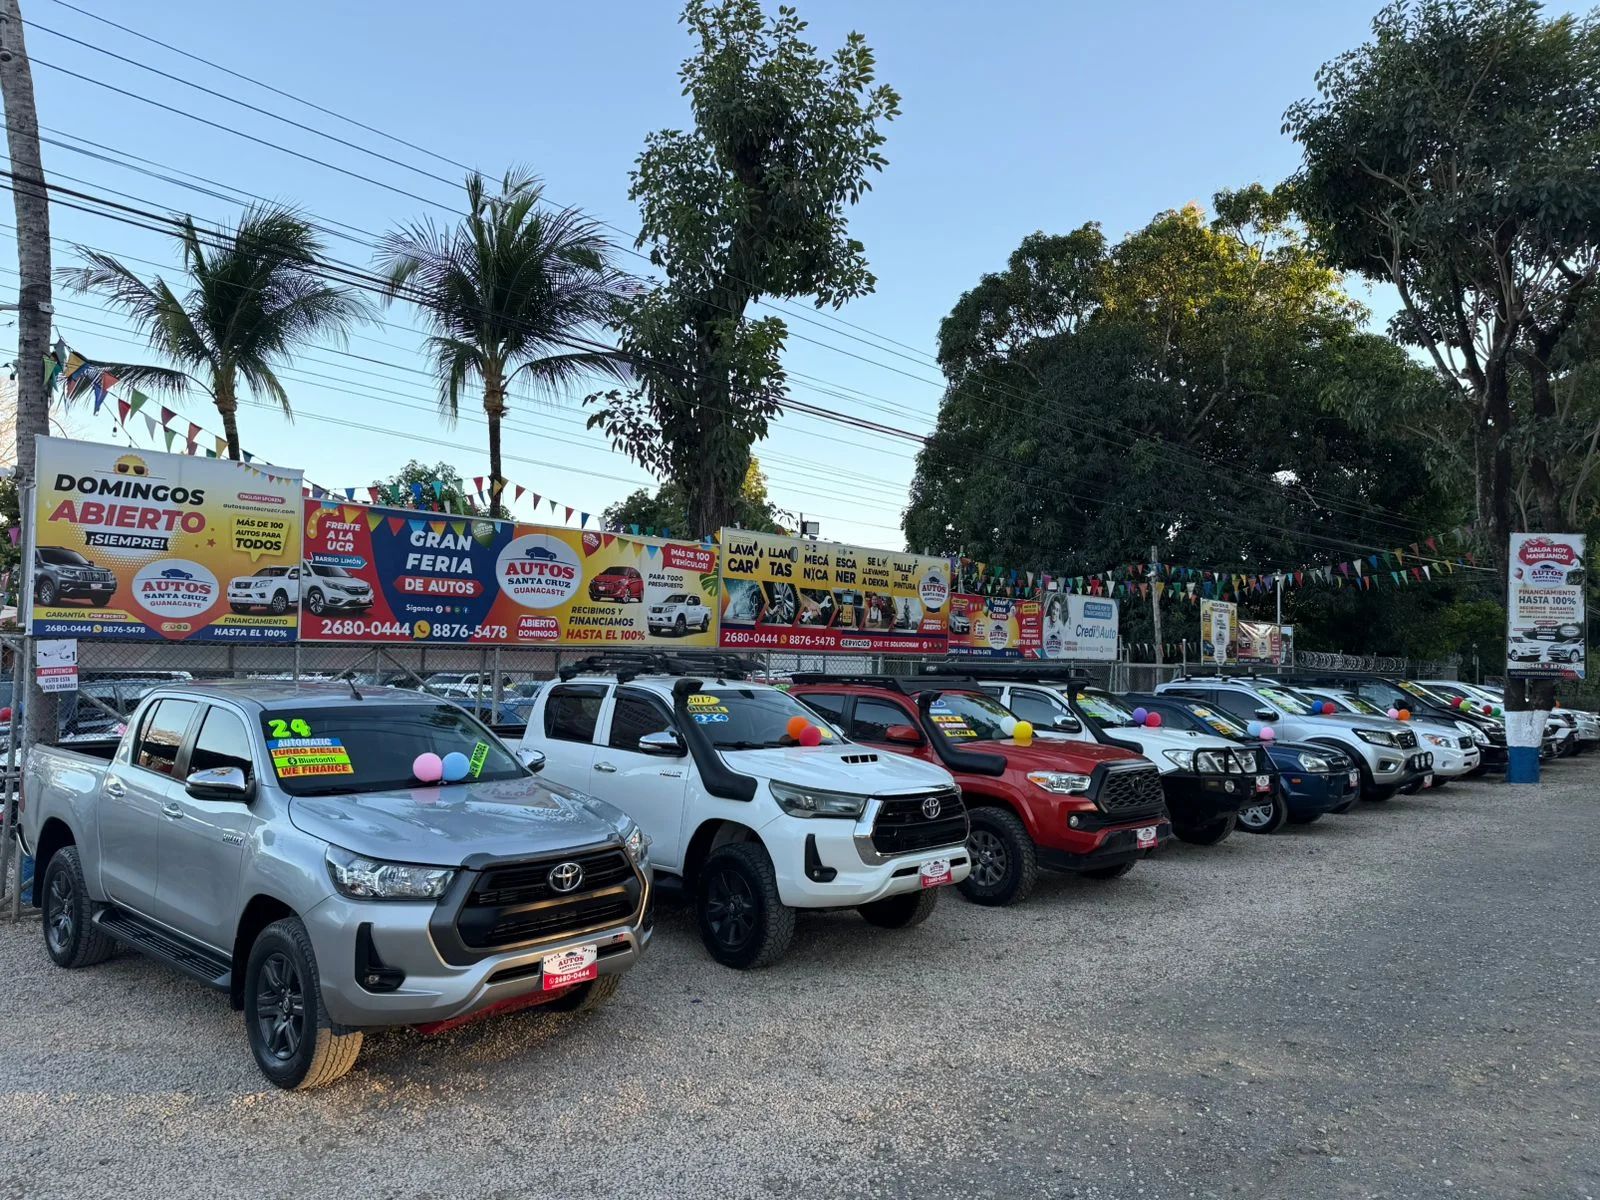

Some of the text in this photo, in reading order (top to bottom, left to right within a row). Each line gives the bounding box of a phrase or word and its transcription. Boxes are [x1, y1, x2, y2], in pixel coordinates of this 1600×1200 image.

[54, 474, 205, 505] DOMINGOS
[48, 500, 206, 533] ABIERTO
[237, 518, 256, 527] MÁS
[257, 520, 269, 528] DE
[326, 521, 361, 531] FRENTE
[90, 534, 165, 549] ¡SIEMPRE!
[327, 531, 354, 541] A LA
[410, 530, 473, 551] GRAN
[236, 538, 282, 551] TODOS
[327, 541, 354, 552] UCR
[729, 543, 755, 557] LAVA
[696, 552, 710, 561] 100
[769, 548, 791, 559] LLAN
[341, 557, 361, 565] LIMÓN
[406, 553, 473, 574] FERIA
[805, 554, 829, 566] MECÁ
[836, 558, 857, 569] ESCA
[868, 557, 876, 566] SE
[505, 562, 575, 580] AUTOS
[728, 558, 754, 574] CAR
[769, 562, 792, 577] TAS
[836, 570, 856, 584] NER
[862, 568, 890, 577] LLEVAMOS
[901, 574, 909, 582] DE
[141, 582, 212, 595] AUTOS
[405, 578, 474, 595] DE AUTOS
[545, 579, 571, 589] CRUZ
[894, 582, 916, 590] PINTURA
[922, 585, 946, 594] AUTOS
[514, 587, 565, 597] GUANACASTE
[181, 594, 208, 602] CRUZ
[1519, 596, 1577, 605] HASTA 100%
[150, 600, 202, 608] GUANACASTE
[406, 604, 434, 613] Síganos
[571, 606, 616, 615] RECIBIMOS
[521, 619, 556, 628] ABIERTO
[569, 616, 634, 627] FINANCIAMOS
[45, 625, 146, 634] 2680-0444 8876-5478
[321, 620, 508, 638] 2680-0444 8876-5478
[518, 630, 558, 638] DOMINGOS
[566, 629, 646, 641] HASTA EL 100%
[724, 632, 836, 646] 2680-0444 8876-5478
[42, 668, 73, 676] ADVERTENCIA
[268, 719, 312, 738] 24
[278, 738, 332, 748] AUTOMATIC
[273, 748, 307, 757] TURBO
[298, 756, 336, 764] Bluetooth
[282, 765, 348, 776] WE FINANCE
[558, 956, 585, 967] AUTOS
[555, 970, 590, 984] 2680-0444
